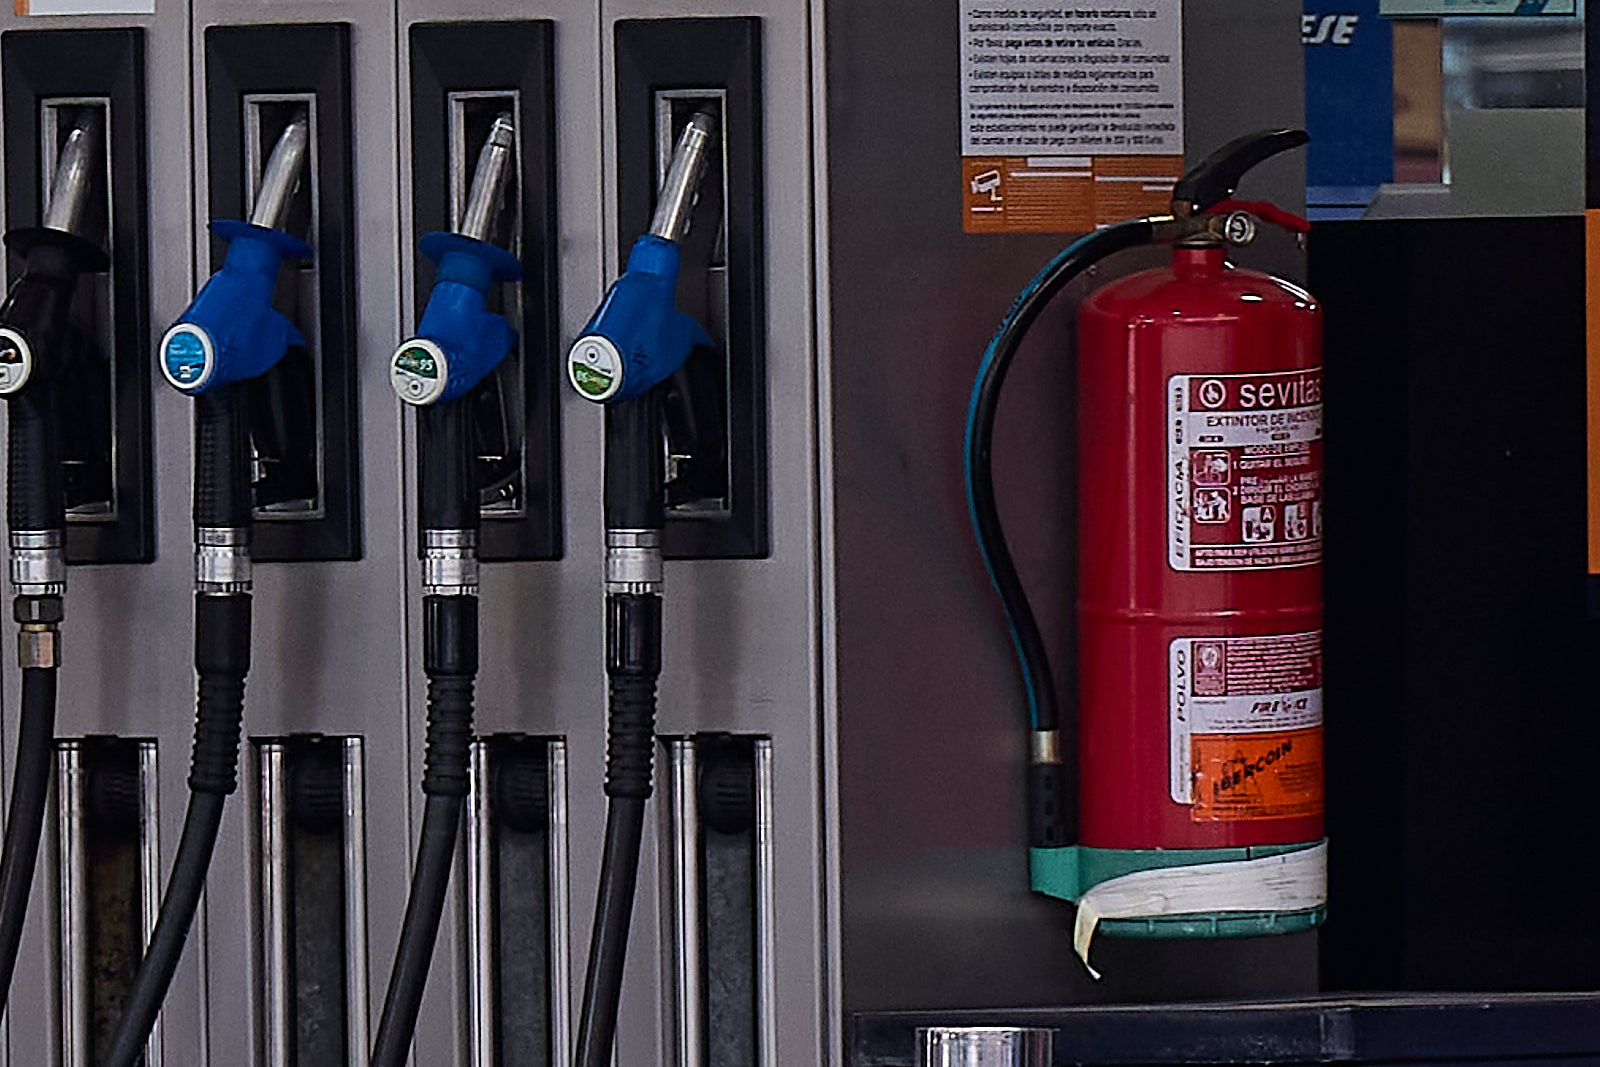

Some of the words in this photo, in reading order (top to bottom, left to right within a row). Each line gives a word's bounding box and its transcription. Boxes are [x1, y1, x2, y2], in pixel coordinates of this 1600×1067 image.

[1206, 415, 1268, 427] EXTINTOR
[1270, 414, 1285, 425] DE
[1176, 649, 1186, 722] POLVO
